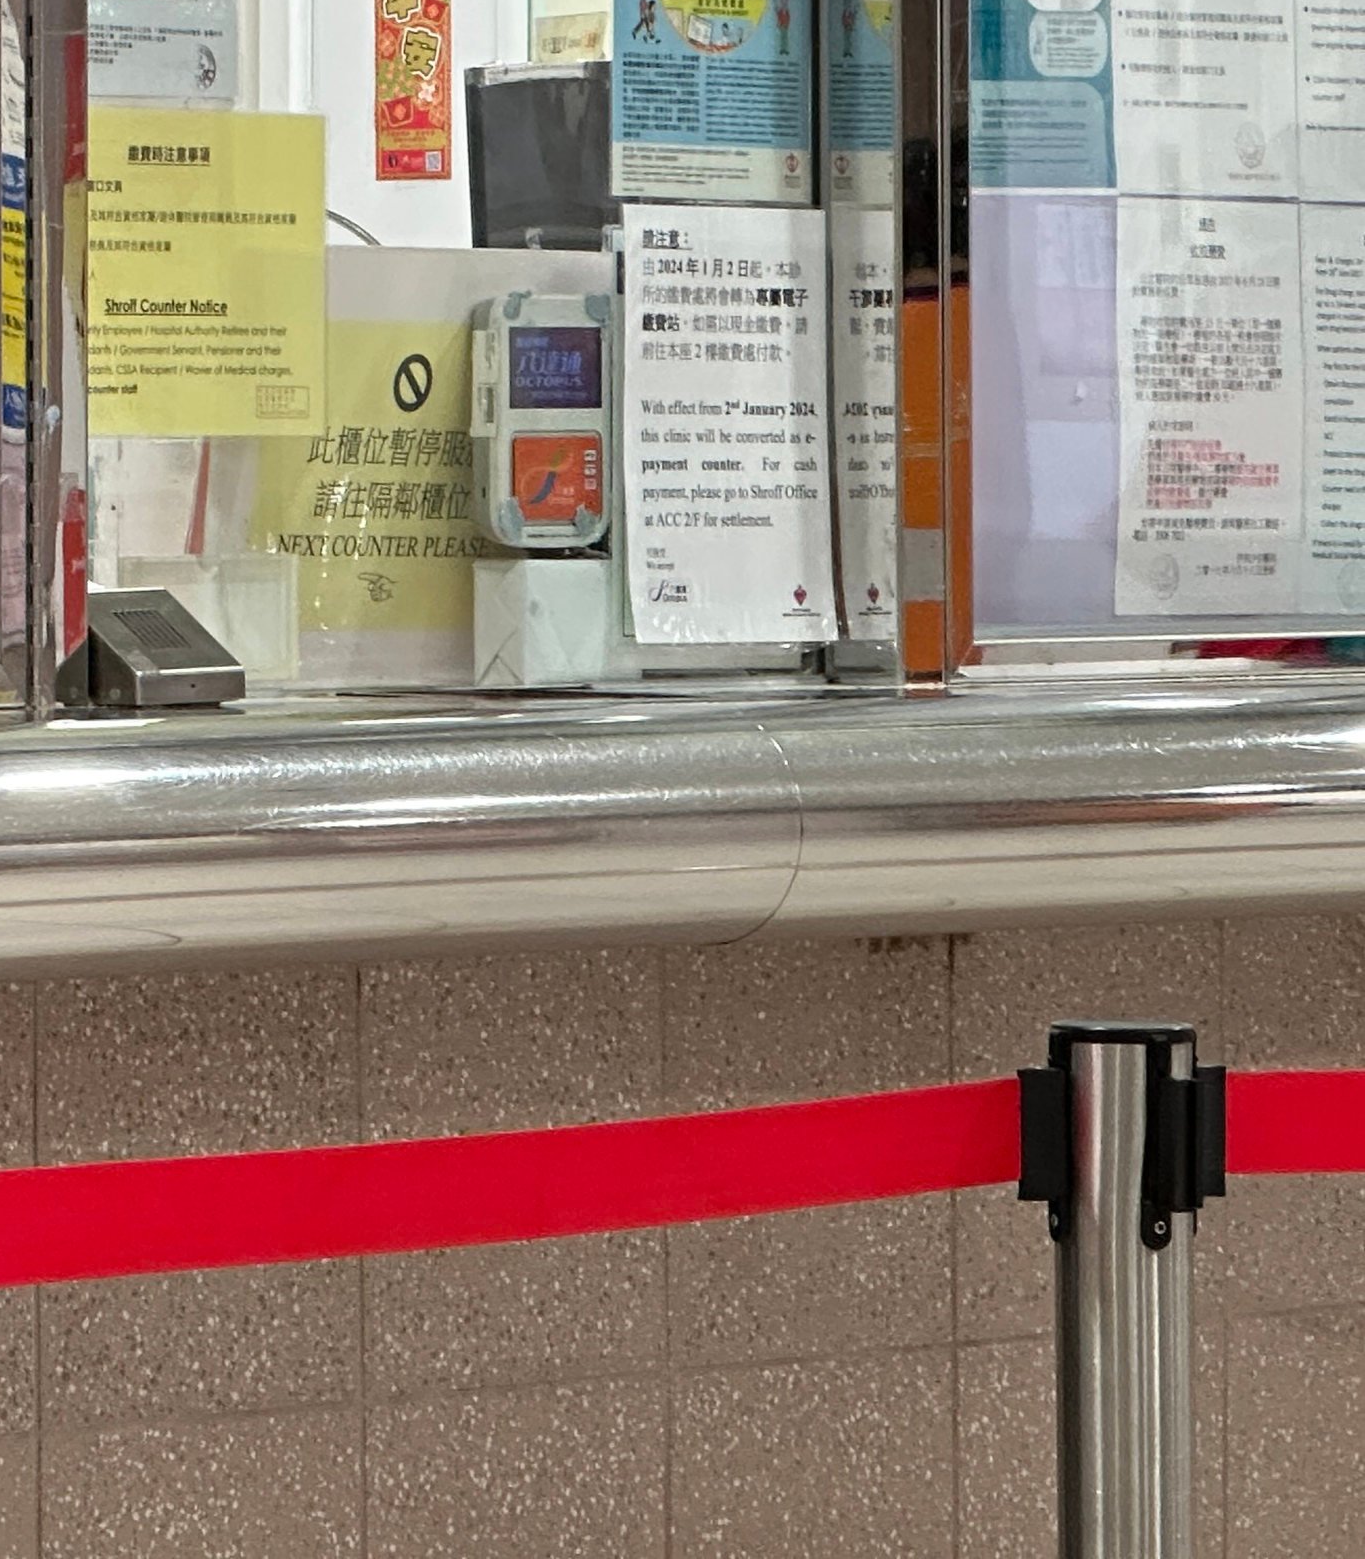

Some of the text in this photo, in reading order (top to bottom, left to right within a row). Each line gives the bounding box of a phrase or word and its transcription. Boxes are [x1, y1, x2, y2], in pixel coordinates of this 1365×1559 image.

[691, 486, 722, 503] please
[724, 489, 737, 503] go
[738, 487, 748, 500] to
[750, 484, 783, 499] Shroff
[785, 484, 818, 499] Office
[277, 534, 489, 558] NEXT COUNTER PLEASE
